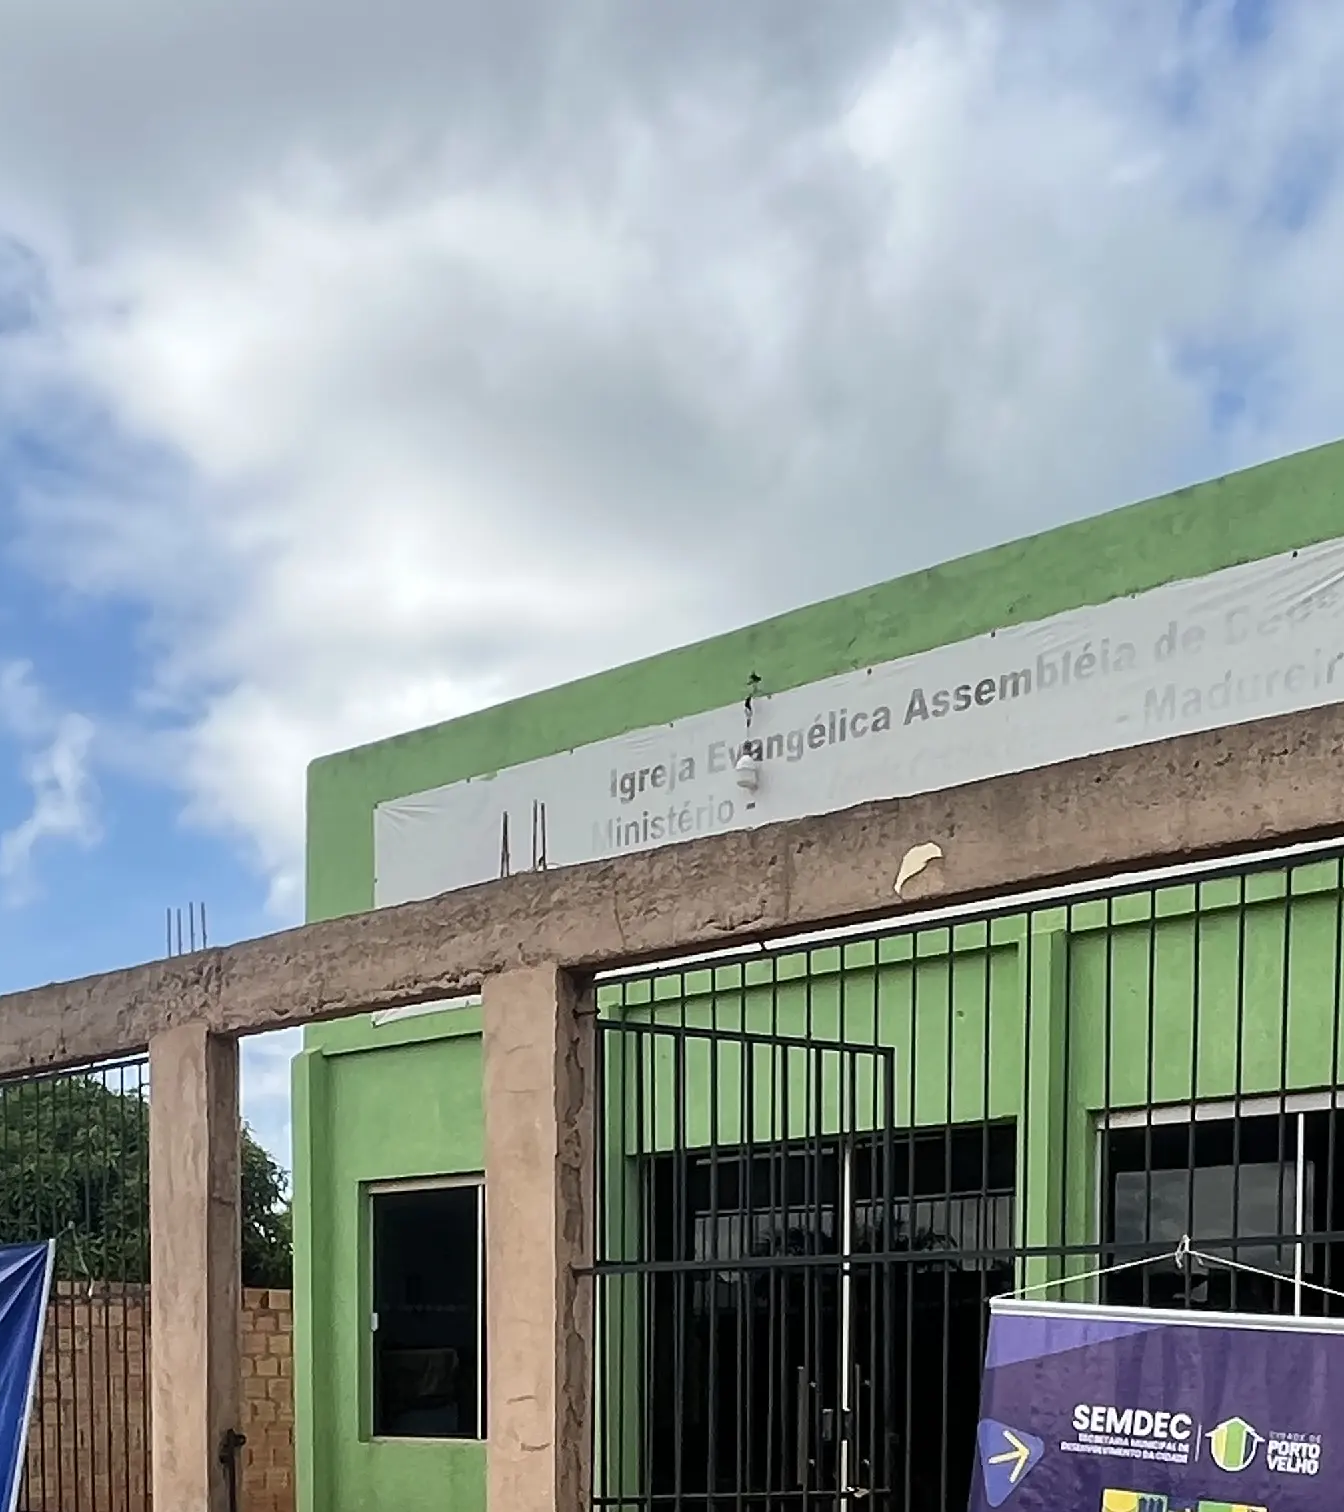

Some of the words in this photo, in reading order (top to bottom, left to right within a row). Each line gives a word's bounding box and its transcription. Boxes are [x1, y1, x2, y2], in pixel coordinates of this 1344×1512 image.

[610, 757, 696, 803] Igreja
[708, 706, 892, 774] Evangélica
[904, 640, 1136, 726] Assembléia
[1155, 620, 1206, 663] de
[591, 796, 735, 853] Ministério
[1072, 1404, 1192, 1440] SEMDEC
[1267, 1440, 1321, 1457] PORTO
[1267, 1454, 1319, 1475] VELHO
